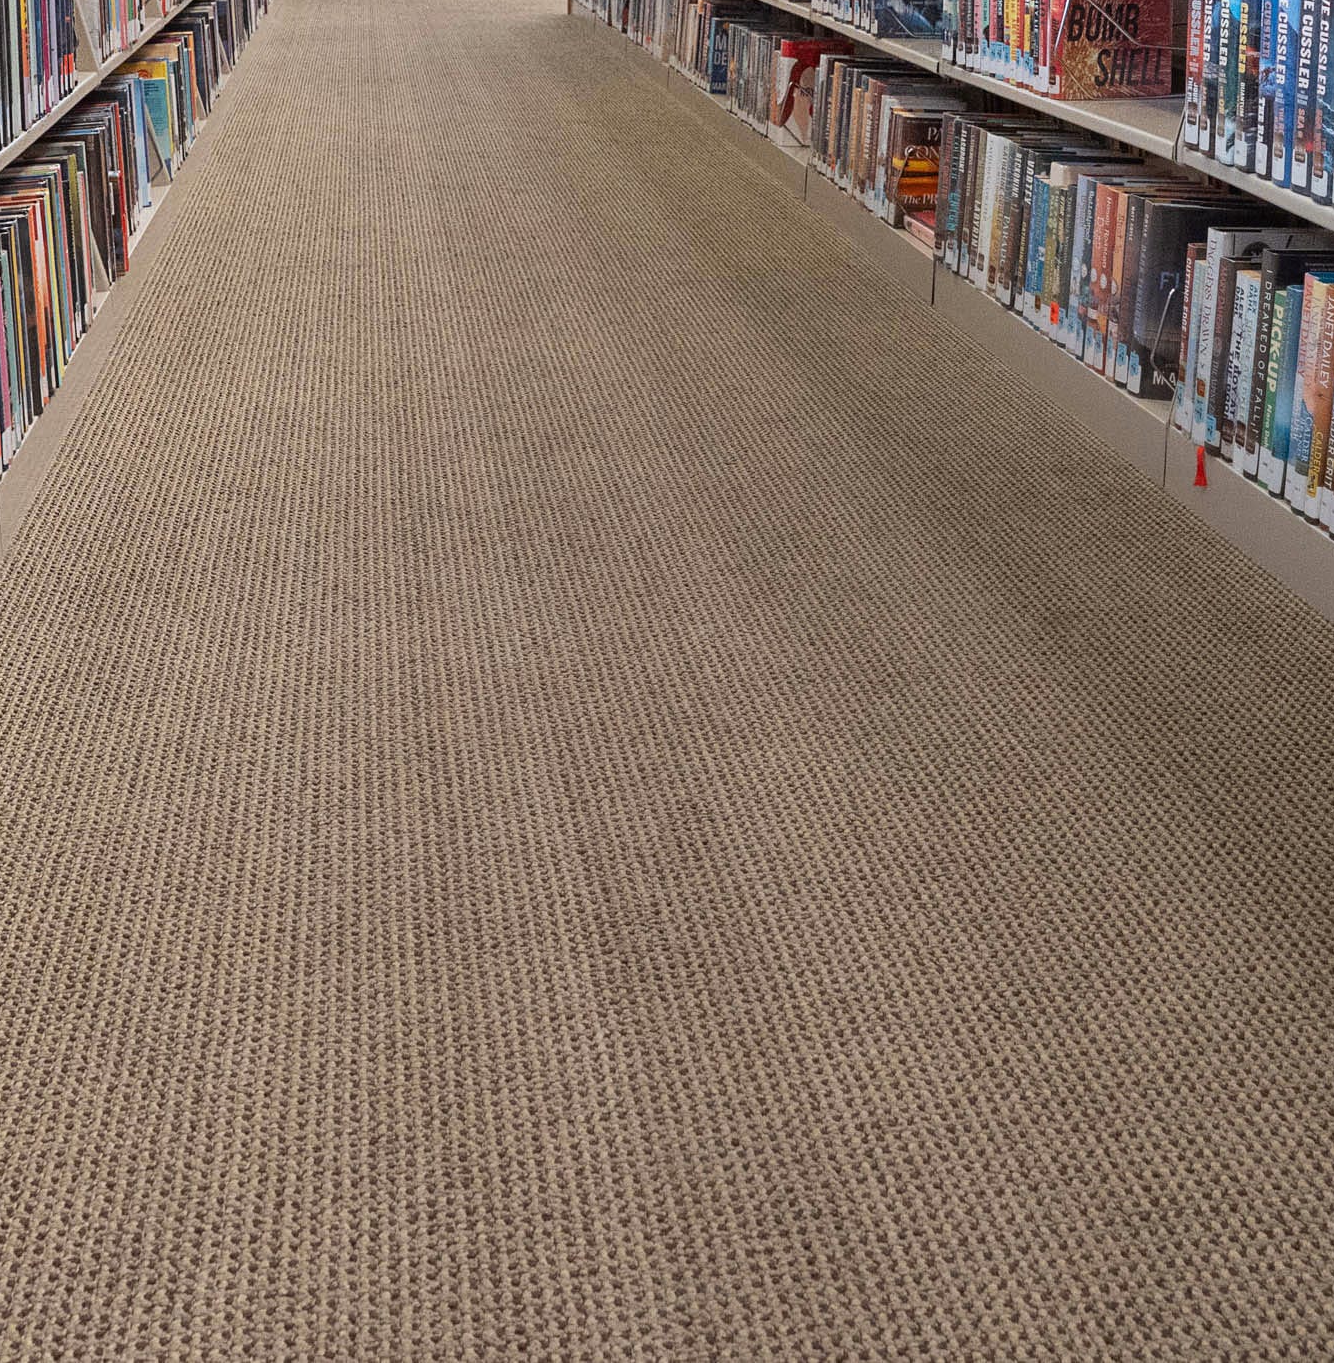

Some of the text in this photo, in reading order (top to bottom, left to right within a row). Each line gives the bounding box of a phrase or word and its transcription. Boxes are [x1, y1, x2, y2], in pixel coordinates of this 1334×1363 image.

[1068, 3, 1141, 42] BOMB
[1094, 49, 1163, 87] SHELL
[1268, 300, 1284, 393] PICK-UP
